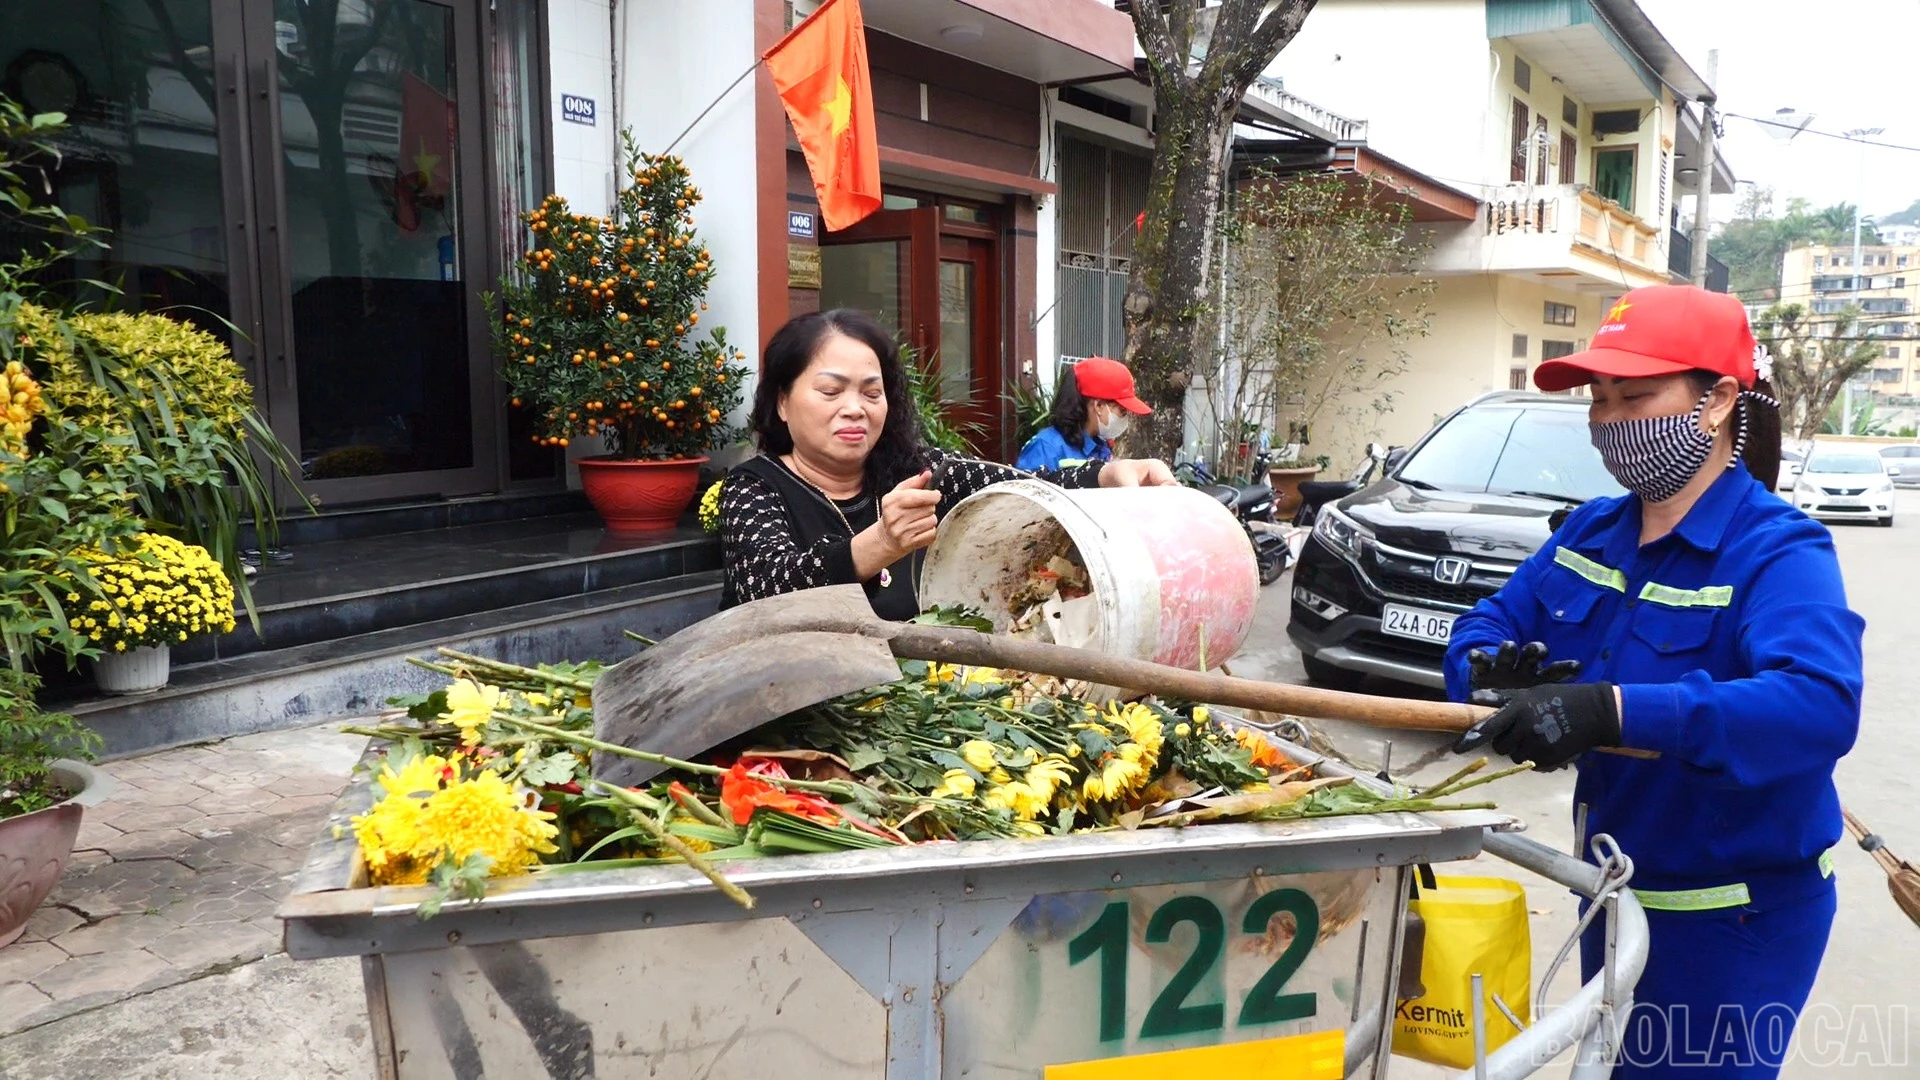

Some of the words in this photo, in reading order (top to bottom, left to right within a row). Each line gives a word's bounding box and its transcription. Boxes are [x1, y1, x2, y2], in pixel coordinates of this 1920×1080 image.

[565, 96, 593, 116] 008
[791, 215, 811, 228] 006
[1068, 887, 1320, 1043] 122
[1395, 999, 1465, 1028] Kermit
